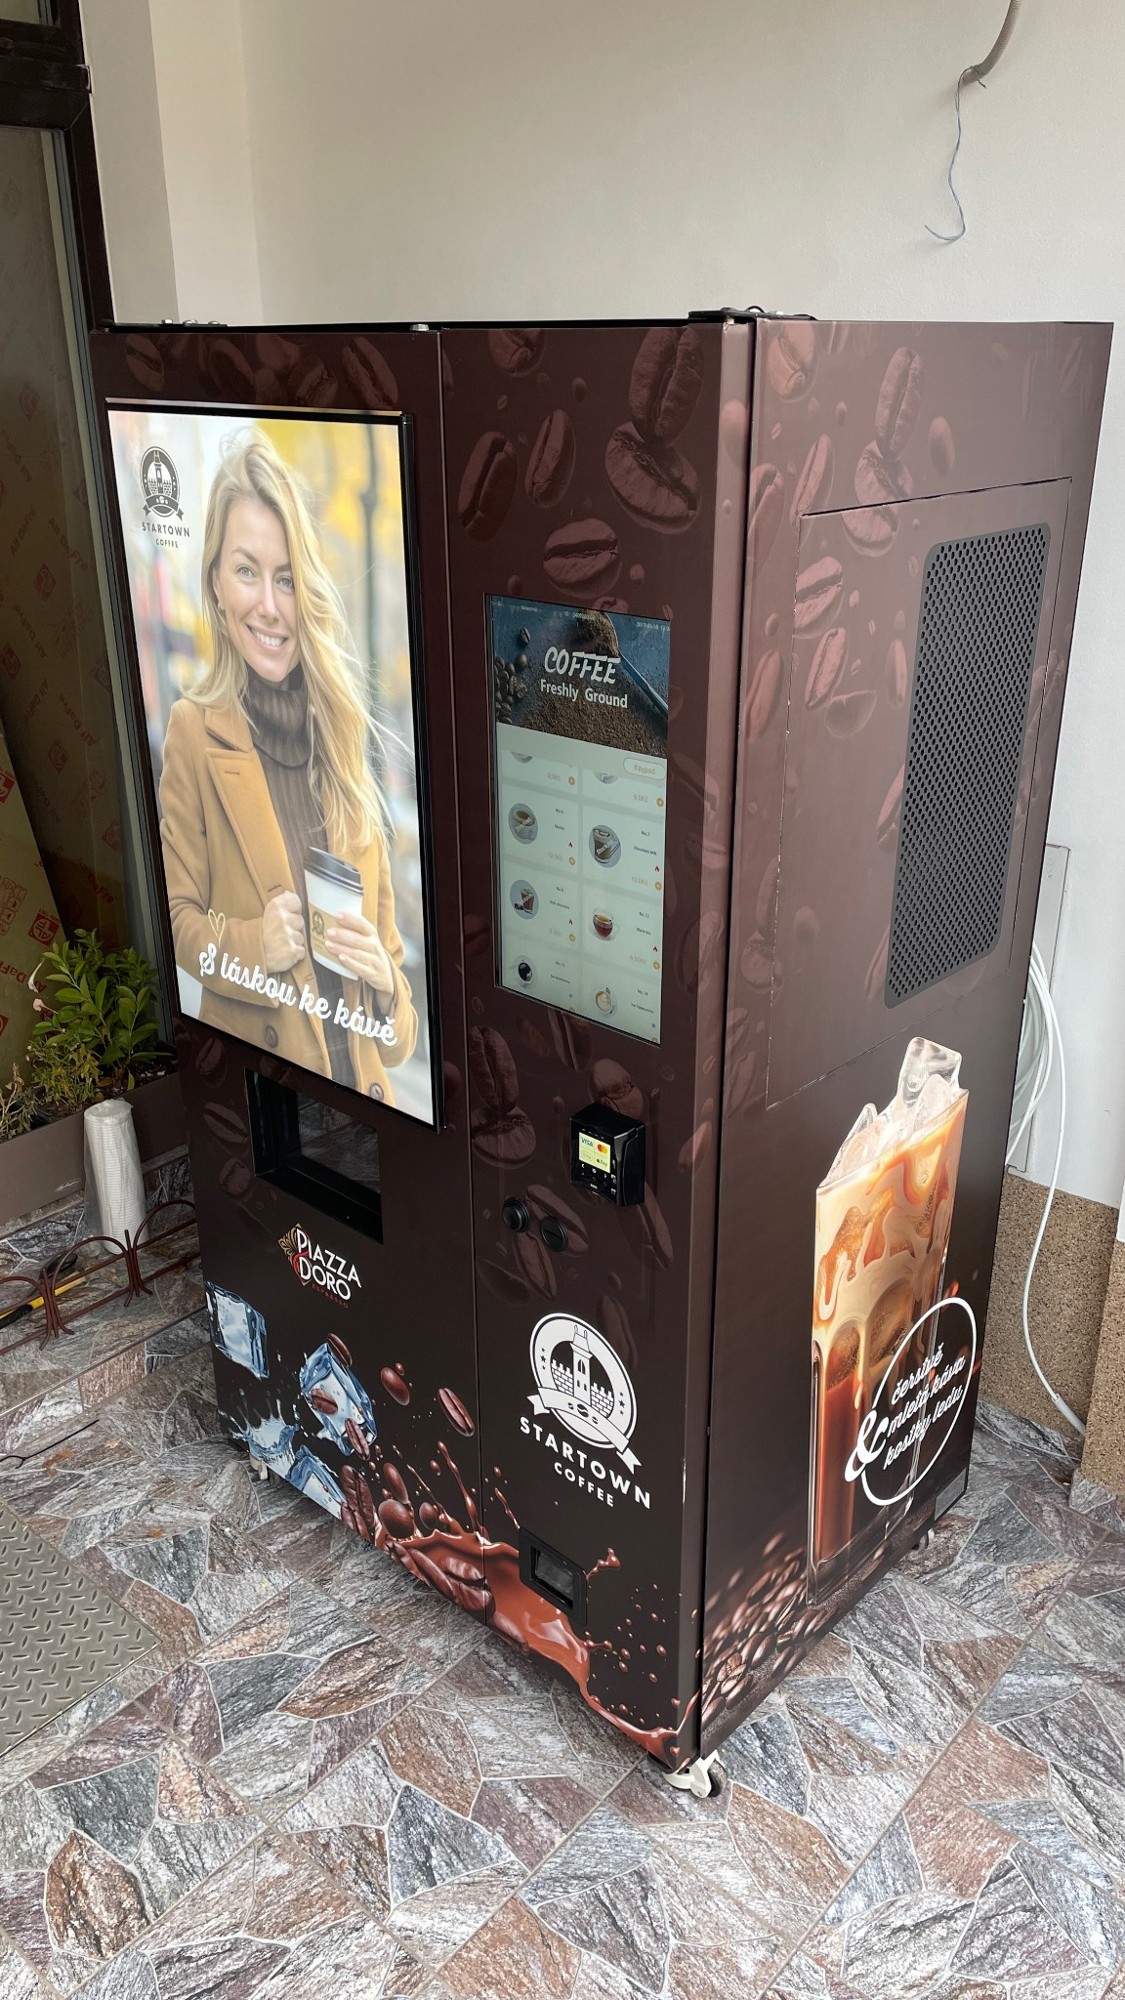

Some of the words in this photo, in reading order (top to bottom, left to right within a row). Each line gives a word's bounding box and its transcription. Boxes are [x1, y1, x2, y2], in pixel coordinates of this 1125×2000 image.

[142, 521, 191, 538] STARTOWN
[155, 538, 179, 549] COFFEE
[544, 646, 622, 685] COFFEE
[540, 679, 579, 702] Freshly
[585, 688, 628, 709] Ground
[199, 942, 218, 978] S
[220, 953, 297, 1007] láskou
[298, 984, 332, 1020] ke
[333, 998, 399, 1047] kávě
[581, 1137, 594, 1148] VISA
[296, 1228, 362, 1288] PIAZZA
[887, 1386, 932, 1438] mletá
[930, 1355, 967, 1398] káva
[932, 1386, 964, 1424] ledu
[519, 1416, 652, 1510] STARTOWN
[553, 1461, 615, 1508] COFFEE
